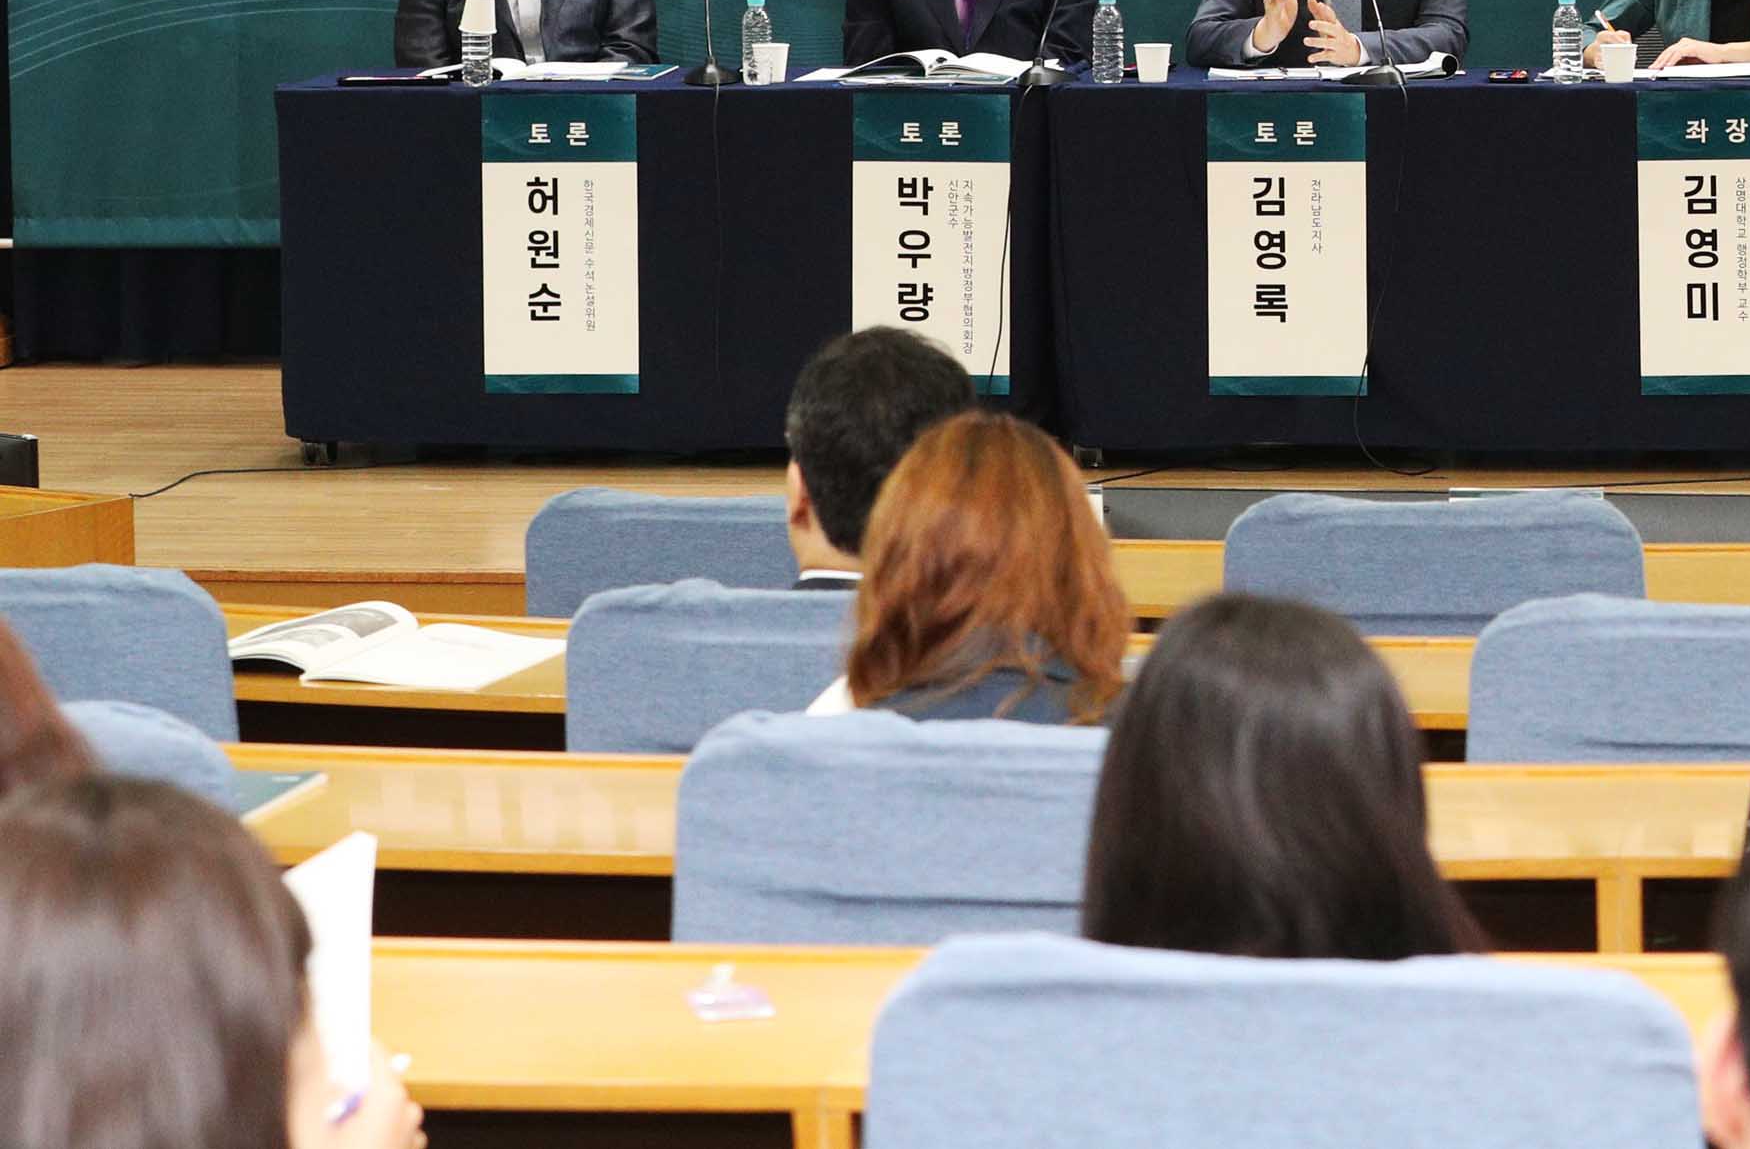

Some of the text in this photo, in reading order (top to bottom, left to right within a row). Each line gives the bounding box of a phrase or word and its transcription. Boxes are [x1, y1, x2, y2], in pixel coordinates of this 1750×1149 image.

[528, 122, 590, 146] 토론
[900, 122, 962, 146] 토론
[1254, 121, 1317, 146] 토론
[1685, 118, 1749, 144] 좌장
[583, 179, 595, 254] 한국경제신문
[947, 179, 960, 229] 신안군수
[1311, 179, 1323, 254] 전라남도지사
[526, 176, 562, 321] 허원순
[896, 177, 934, 323] 박우량
[1252, 177, 1289, 323] 김영록
[1684, 175, 1719, 321] 김영미
[1735, 177, 1749, 322] 상명대학교 행정학부 교수
